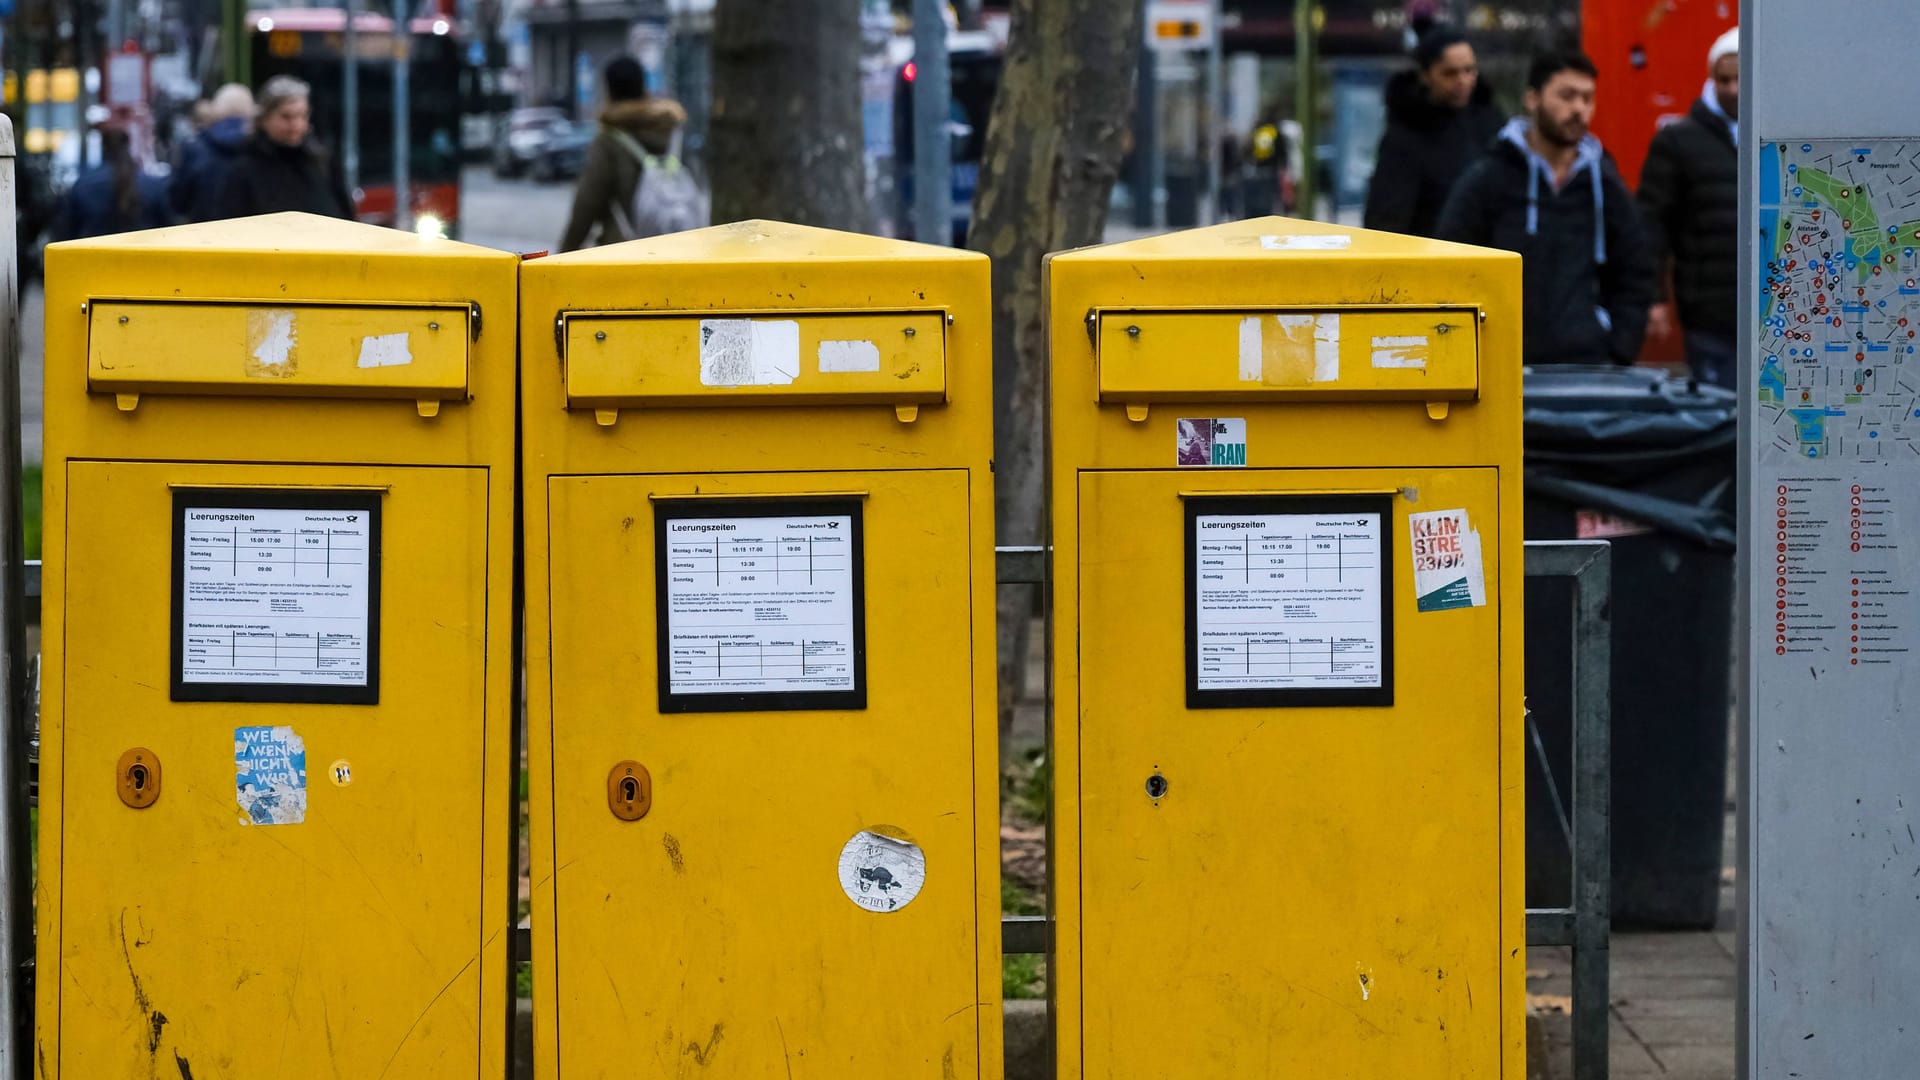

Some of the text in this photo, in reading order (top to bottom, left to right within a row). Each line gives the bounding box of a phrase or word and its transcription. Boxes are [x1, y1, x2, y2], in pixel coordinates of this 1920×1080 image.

[1212, 443, 1246, 465] IRAN
[190, 513, 255, 522] Leerungszeiten
[672, 524, 736, 532] Leerungszeiten
[1202, 521, 1266, 530] Leerungszeiten
